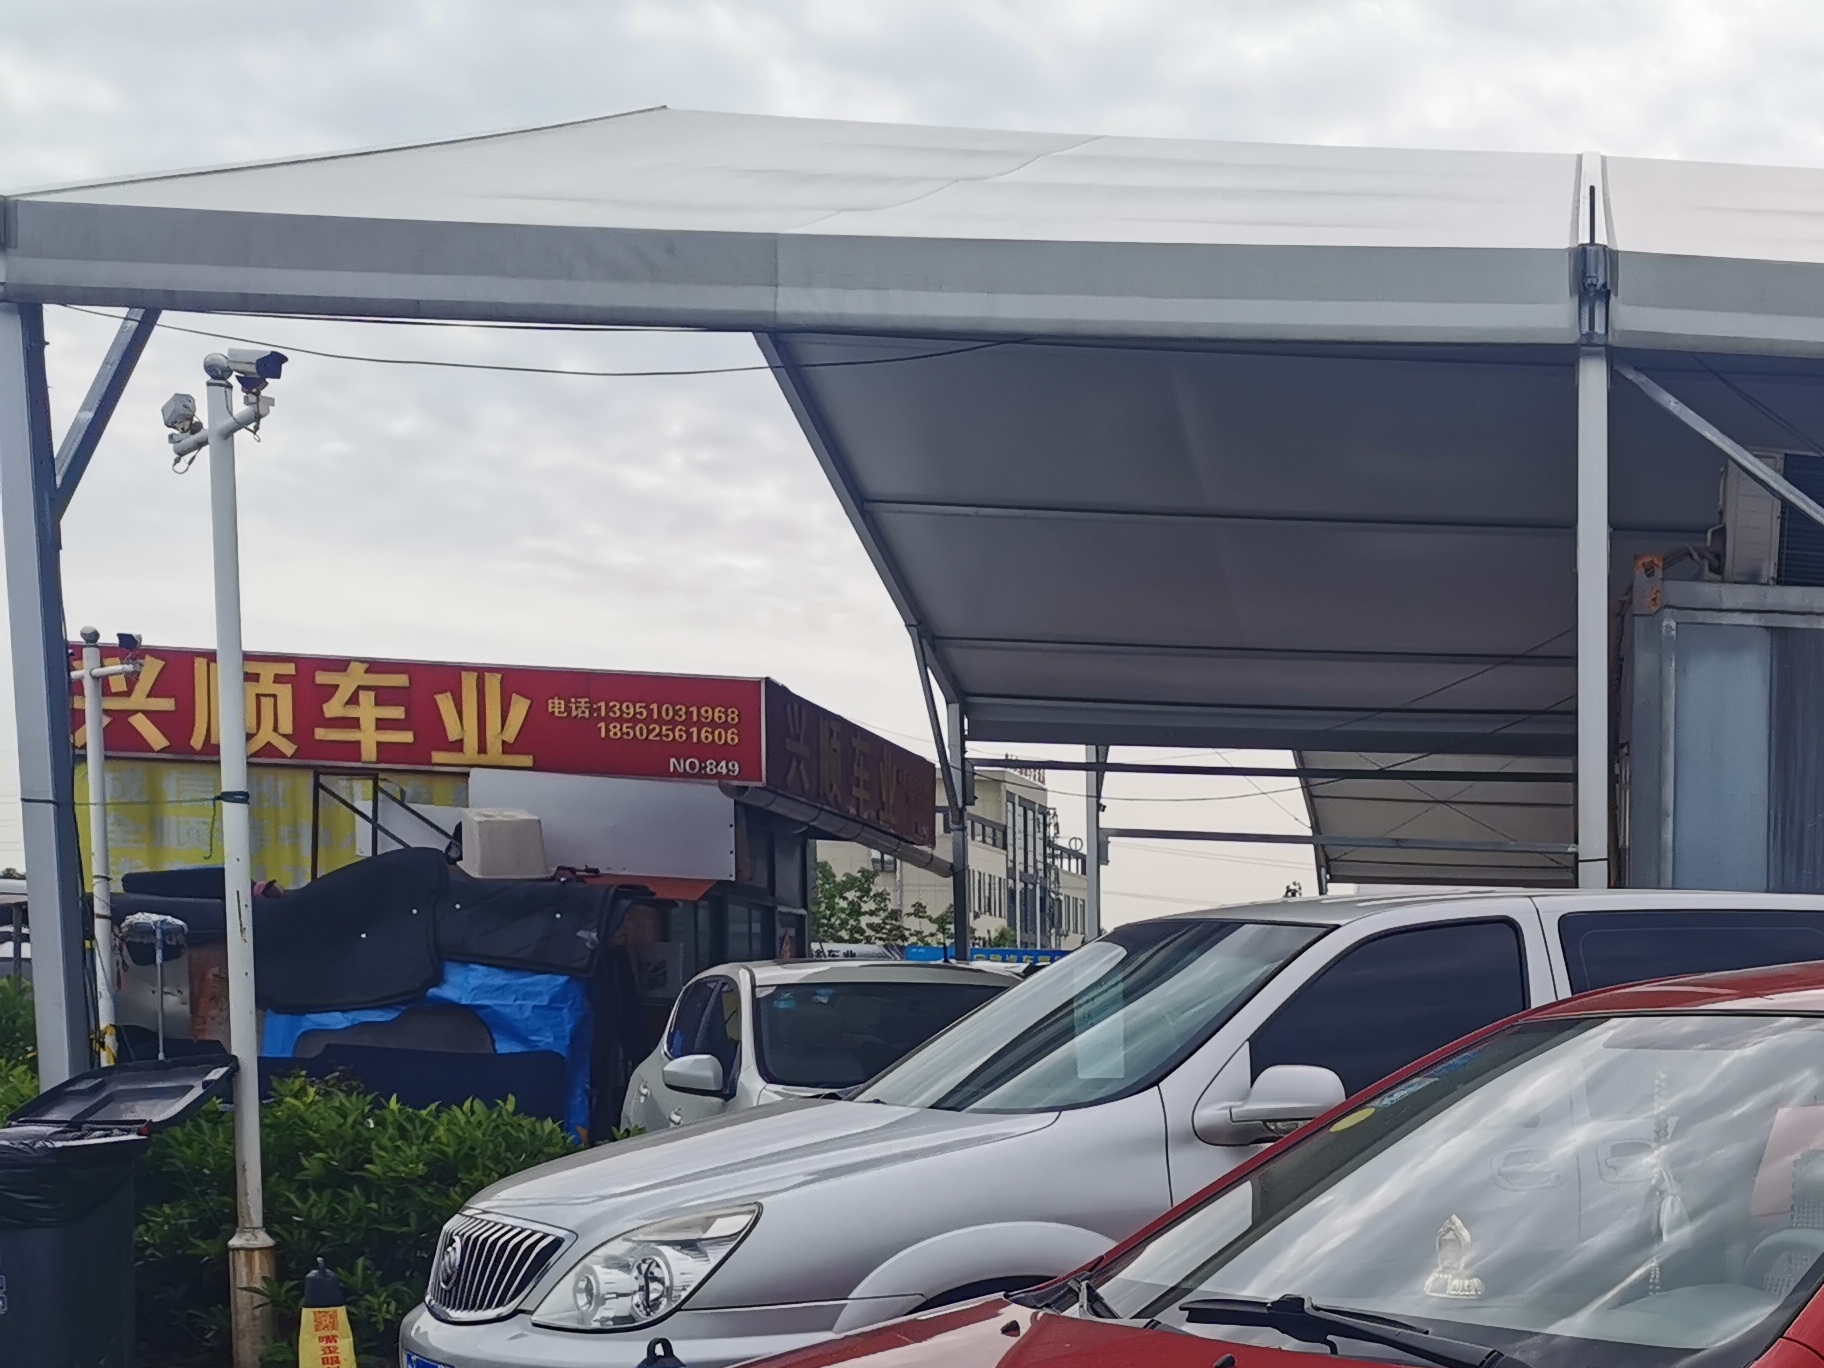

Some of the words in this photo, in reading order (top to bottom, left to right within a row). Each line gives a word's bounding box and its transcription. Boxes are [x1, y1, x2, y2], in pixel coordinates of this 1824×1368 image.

[70, 654, 534, 768] 兴顺车业
[596, 721, 740, 746] 18502561606
[669, 757, 740, 776] NO:849
[785, 701, 897, 824] 兴顺车业
